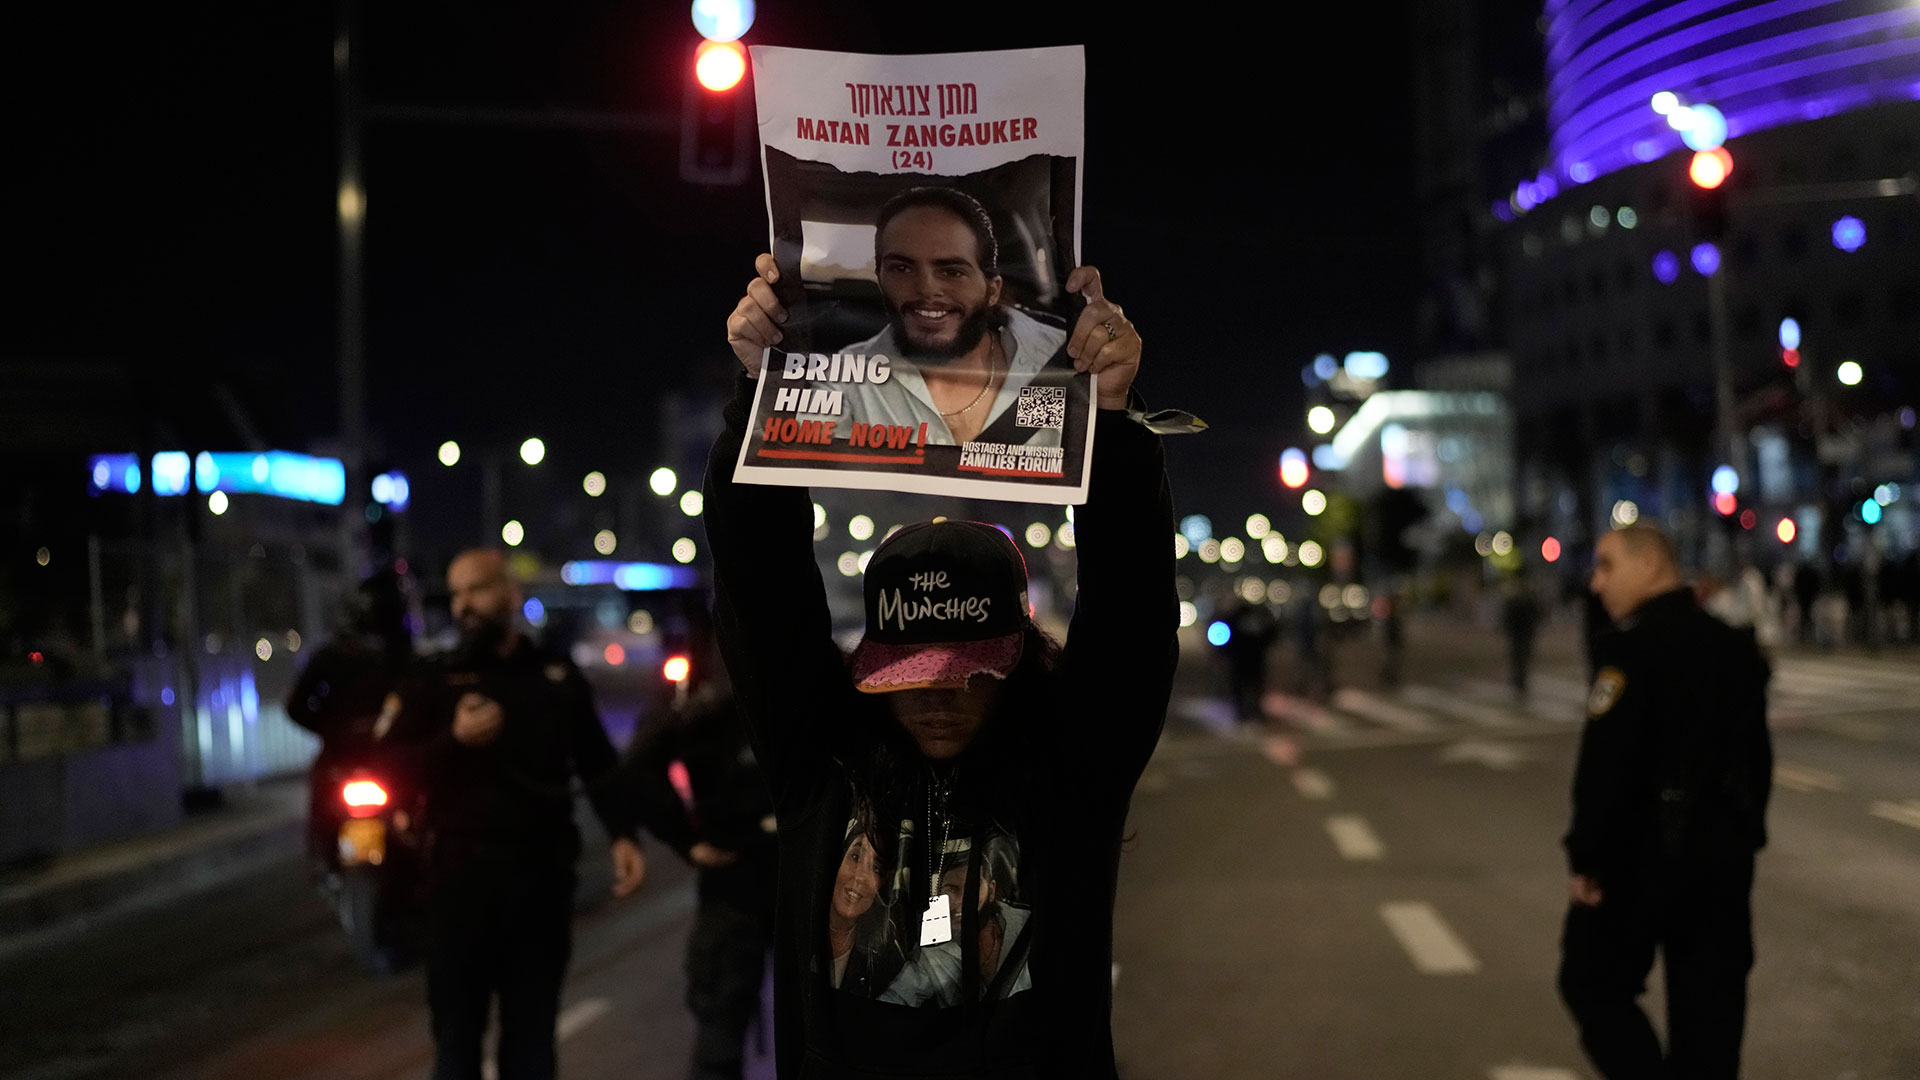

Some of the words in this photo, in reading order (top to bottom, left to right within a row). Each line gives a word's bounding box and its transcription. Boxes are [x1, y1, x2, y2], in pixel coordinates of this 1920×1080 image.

[845, 82, 931, 118] צנגאוקר
[936, 82, 978, 119] מתן
[796, 117, 870, 146] MATAN
[886, 117, 1038, 148] ZANGAUKER
[892, 150, 933, 171] (24)
[782, 352, 891, 385] BRING
[773, 387, 843, 416] HIM
[762, 417, 836, 445] HOME
[848, 421, 928, 456] NOW!
[962, 441, 1007, 455] HOSTAGES
[1006, 444, 1026, 456] AND
[1026, 446, 1064, 459] MISSING
[960, 452, 1016, 470] FAMILIES
[1017, 456, 1063, 473] FORUM
